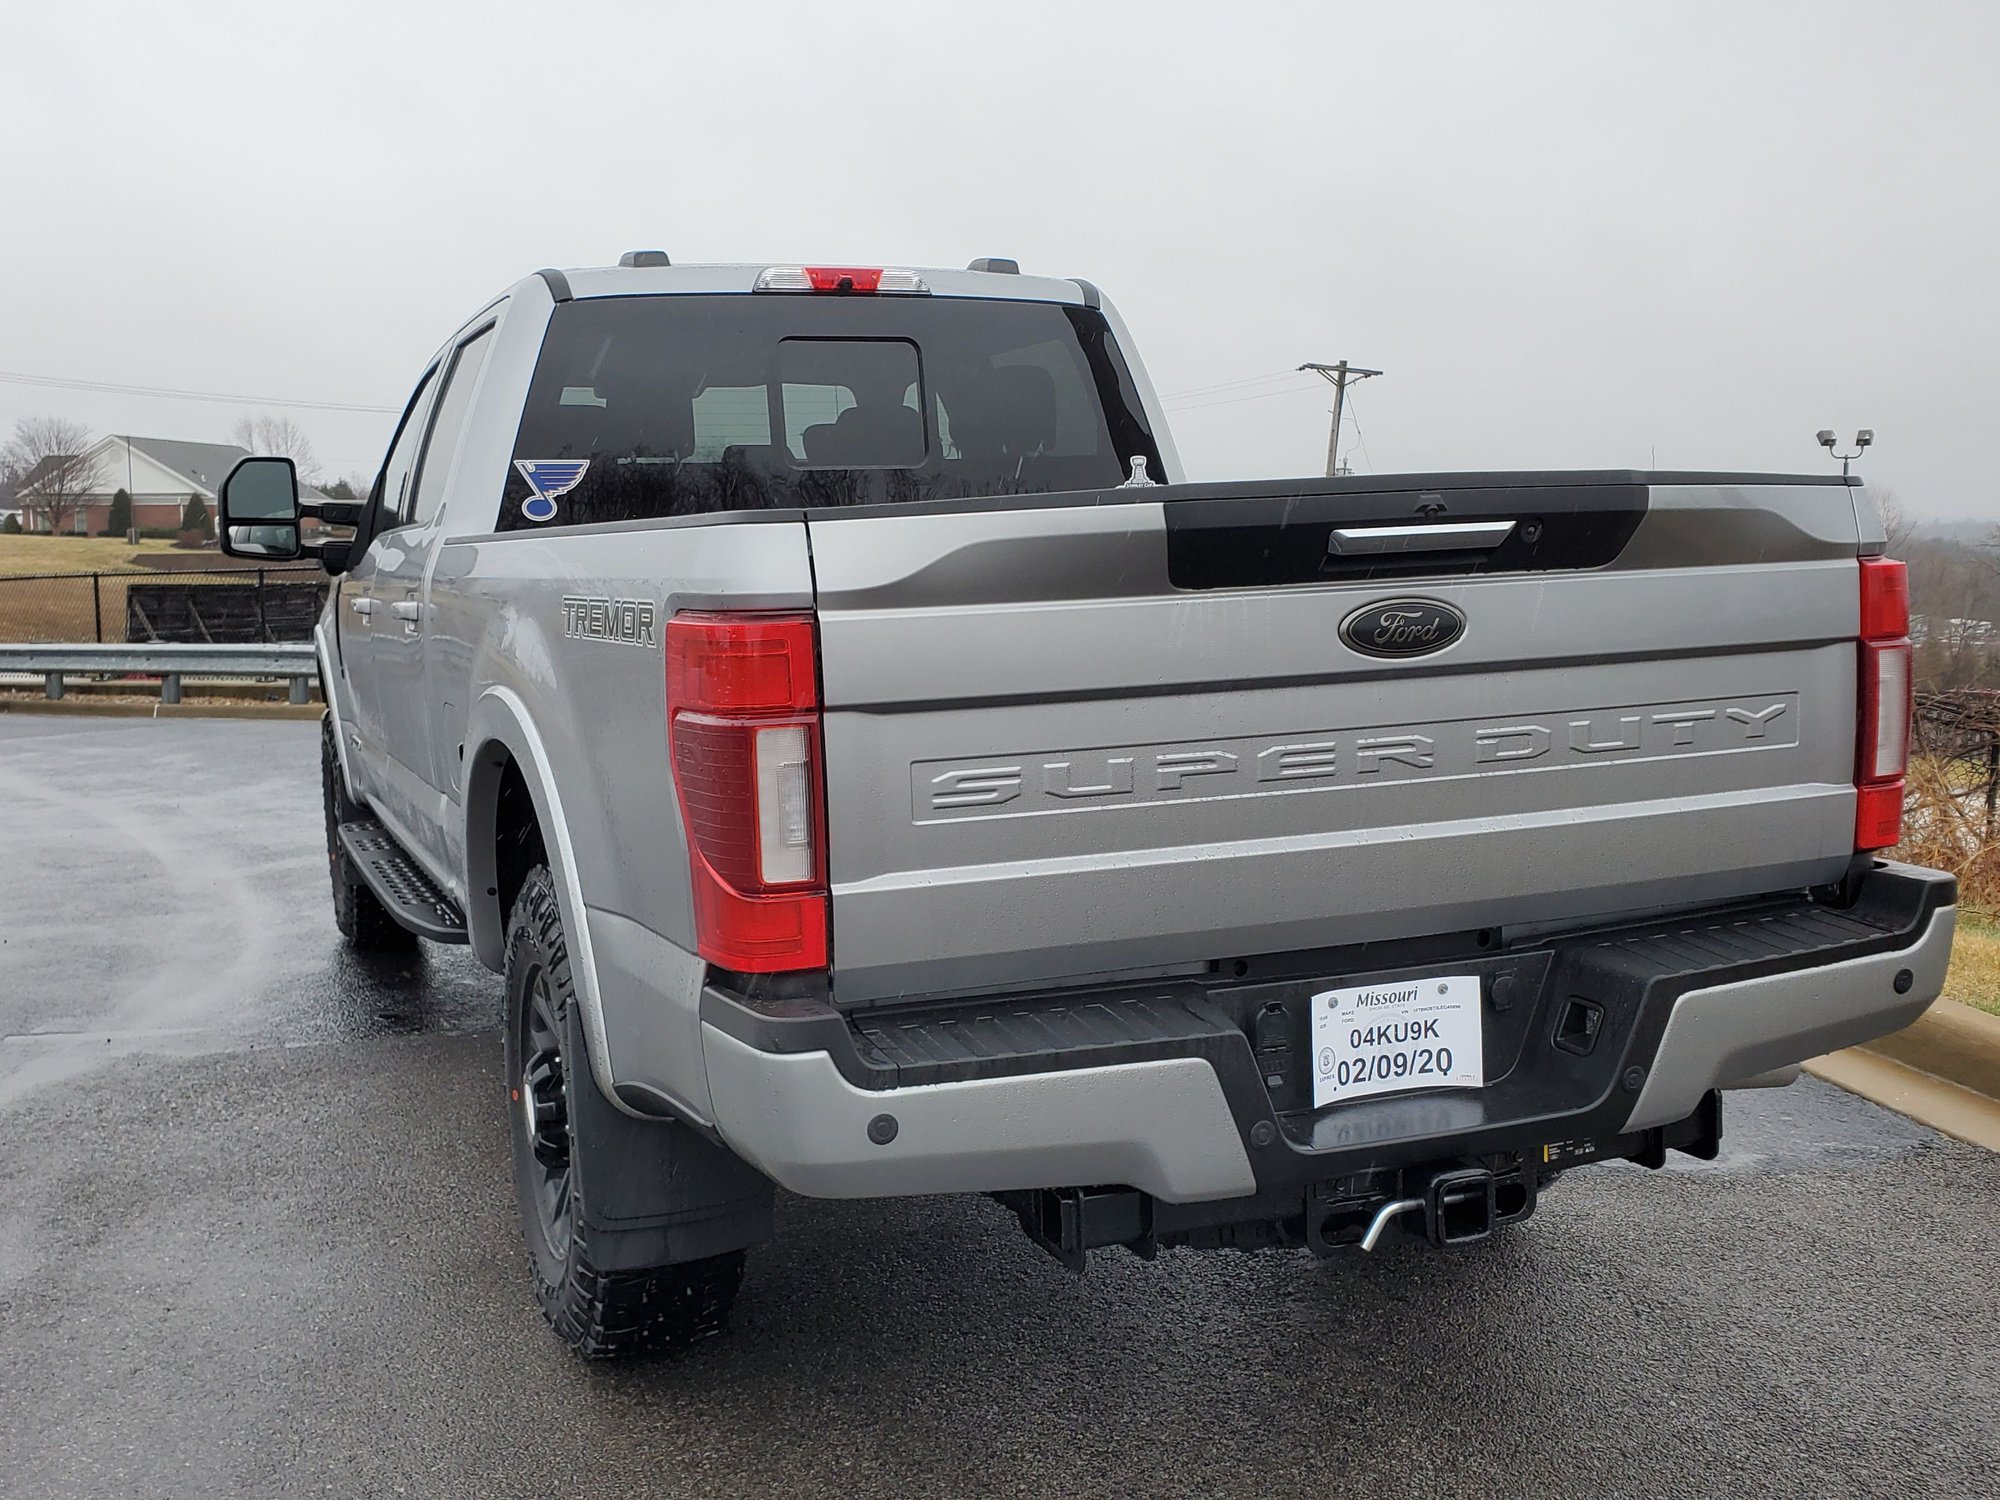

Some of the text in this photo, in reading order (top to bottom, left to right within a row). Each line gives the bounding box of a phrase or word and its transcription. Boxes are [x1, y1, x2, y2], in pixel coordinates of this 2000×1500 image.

[561, 595, 657, 648] TREMOR
[1374, 611, 1440, 645] Ford
[932, 703, 1787, 809] SUPER DUTY
[1356, 986, 1418, 1007] Missouri
[1350, 1018, 1440, 1048] 04KU9K
[1337, 1047, 1452, 1086] 02/09/20
